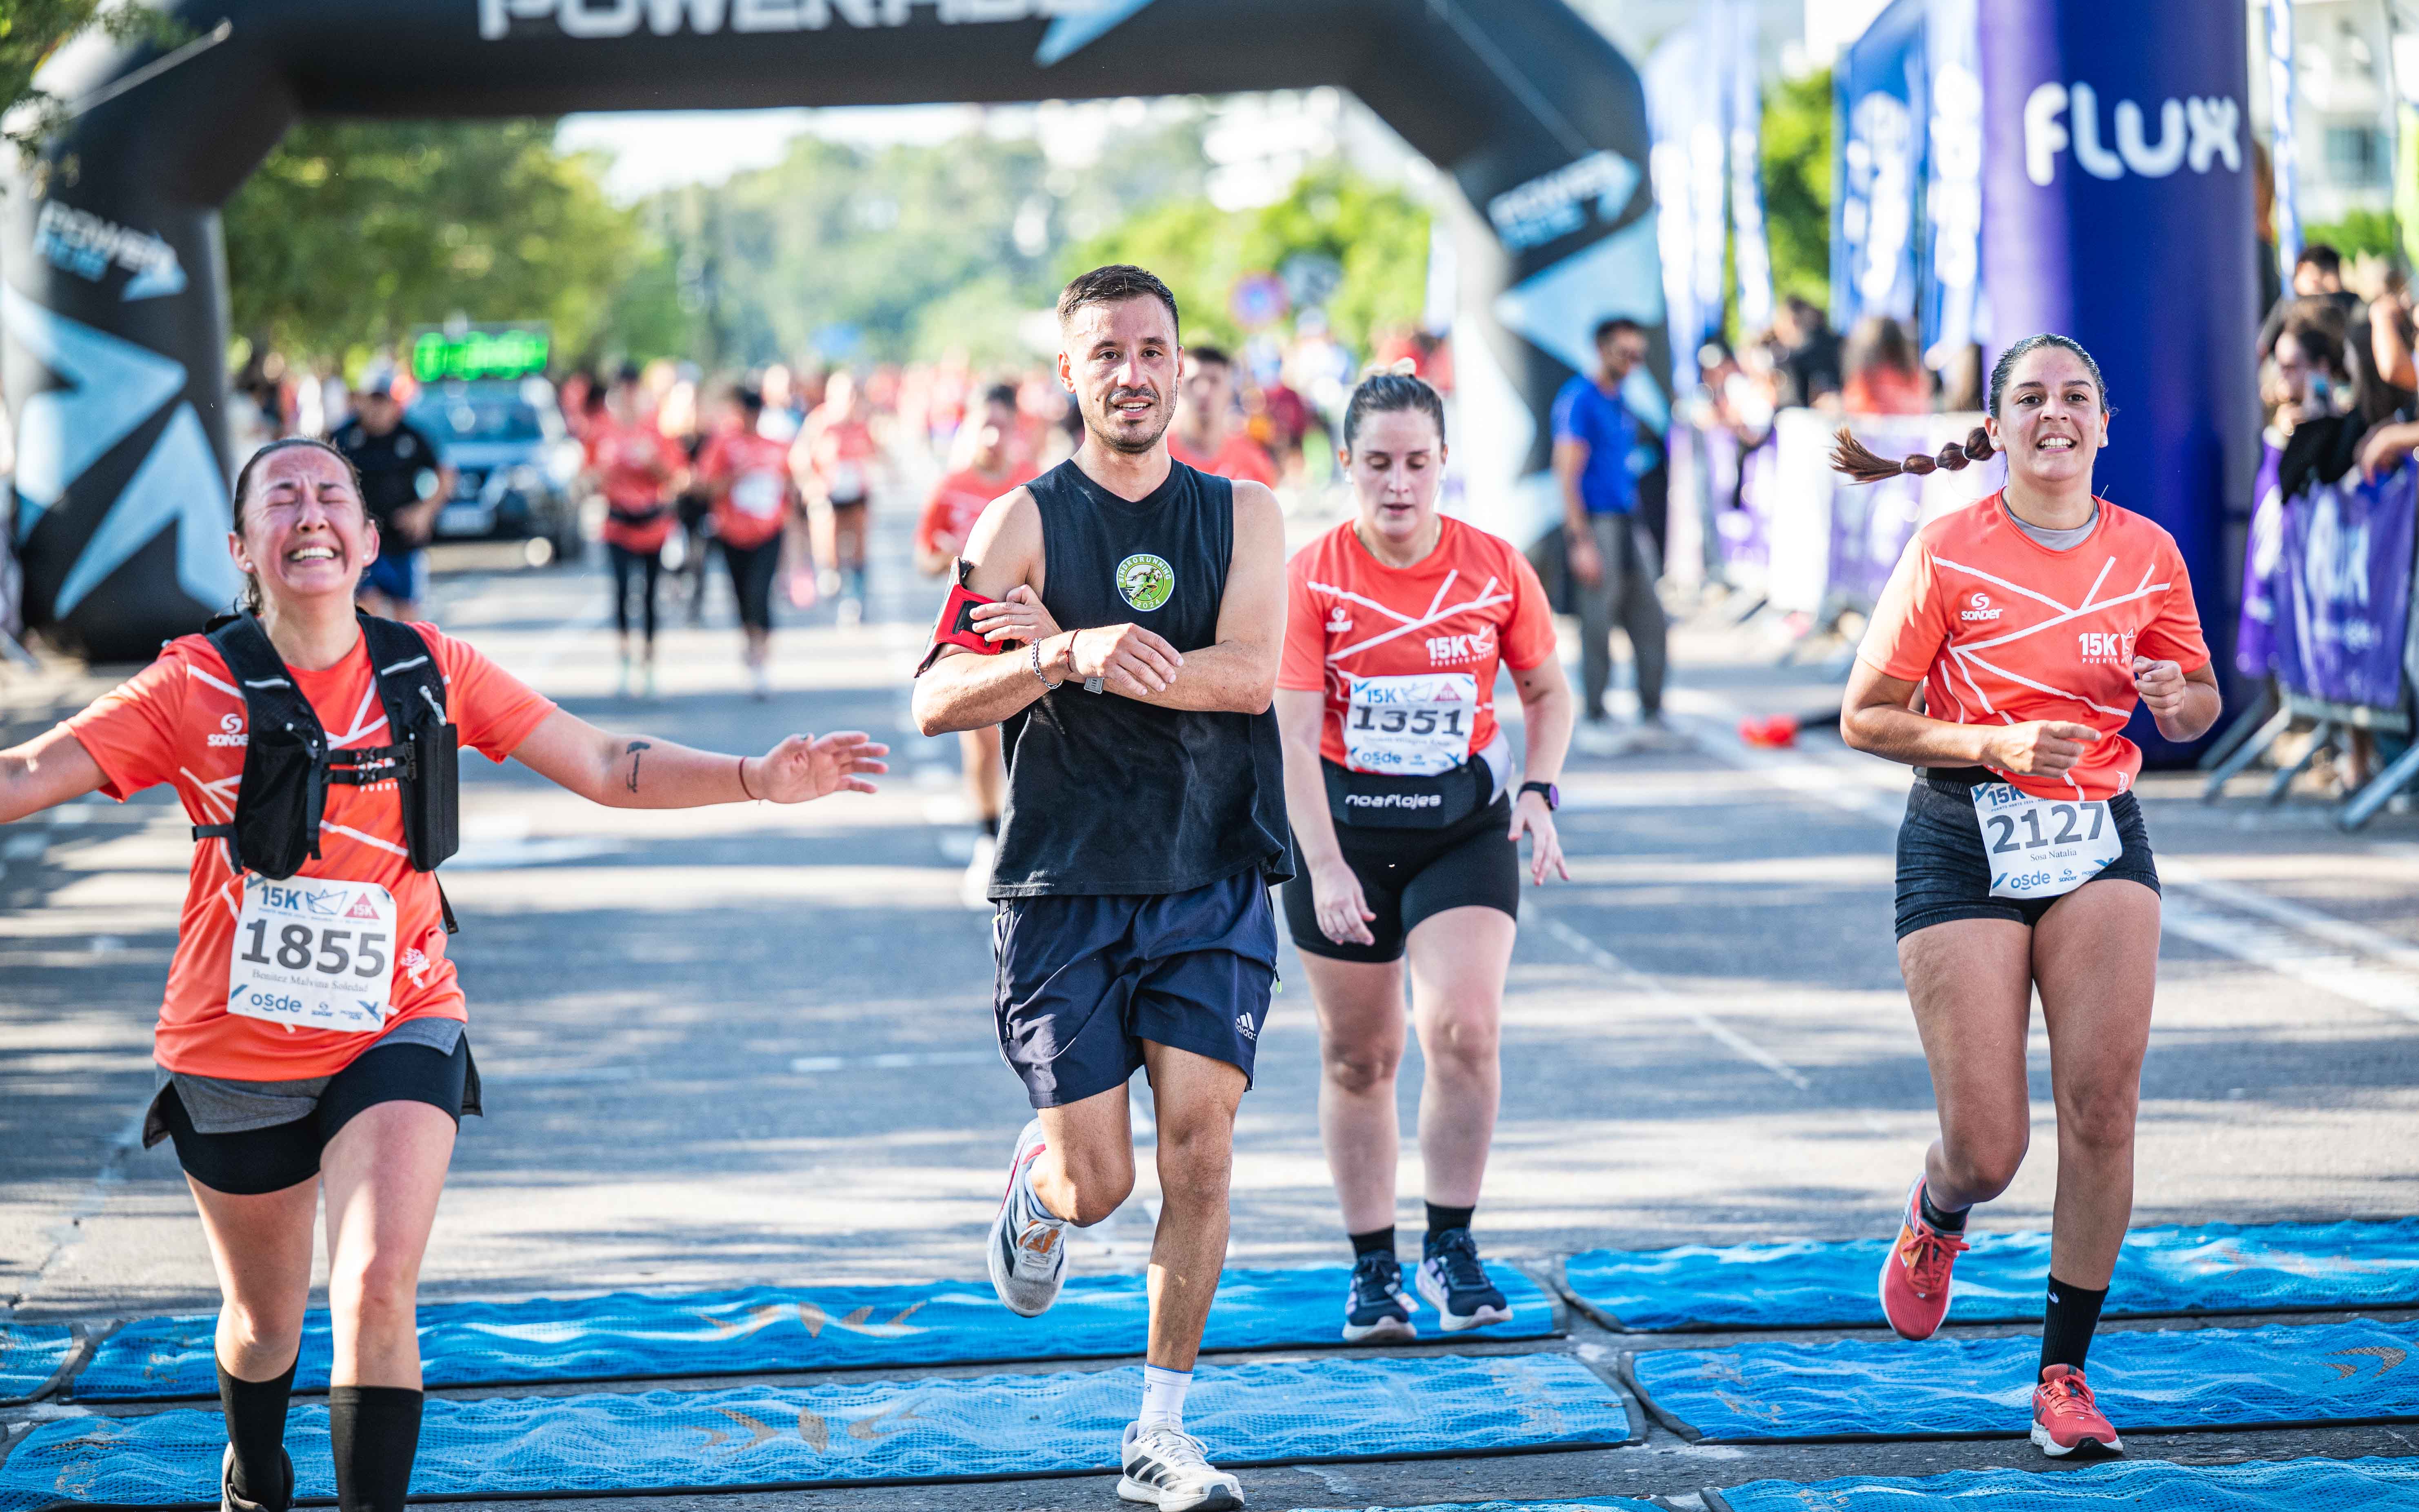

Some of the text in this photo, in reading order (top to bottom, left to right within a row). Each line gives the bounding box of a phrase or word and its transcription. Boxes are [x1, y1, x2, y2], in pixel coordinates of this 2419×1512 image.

[1119, 557, 1171, 583] SINDRORUNNING
[1137, 599, 1160, 608] 2024
[1425, 635, 1469, 660] 15K
[2079, 633, 2119, 656] 15K
[1367, 688, 1397, 703] 15K
[1353, 706, 1464, 736] 1351
[1362, 751, 1402, 765] osde
[360, 782, 398, 793] PUERT
[1988, 785, 2026, 806] 15K
[1345, 794, 1442, 809] noaflojes
[1986, 802, 2104, 854] 2127
[2030, 849, 2077, 862] Sosa Natalia
[2010, 870, 2050, 890] osde
[261, 886, 301, 910] 15K
[241, 918, 386, 978] 1855
[251, 993, 302, 1012] osde
